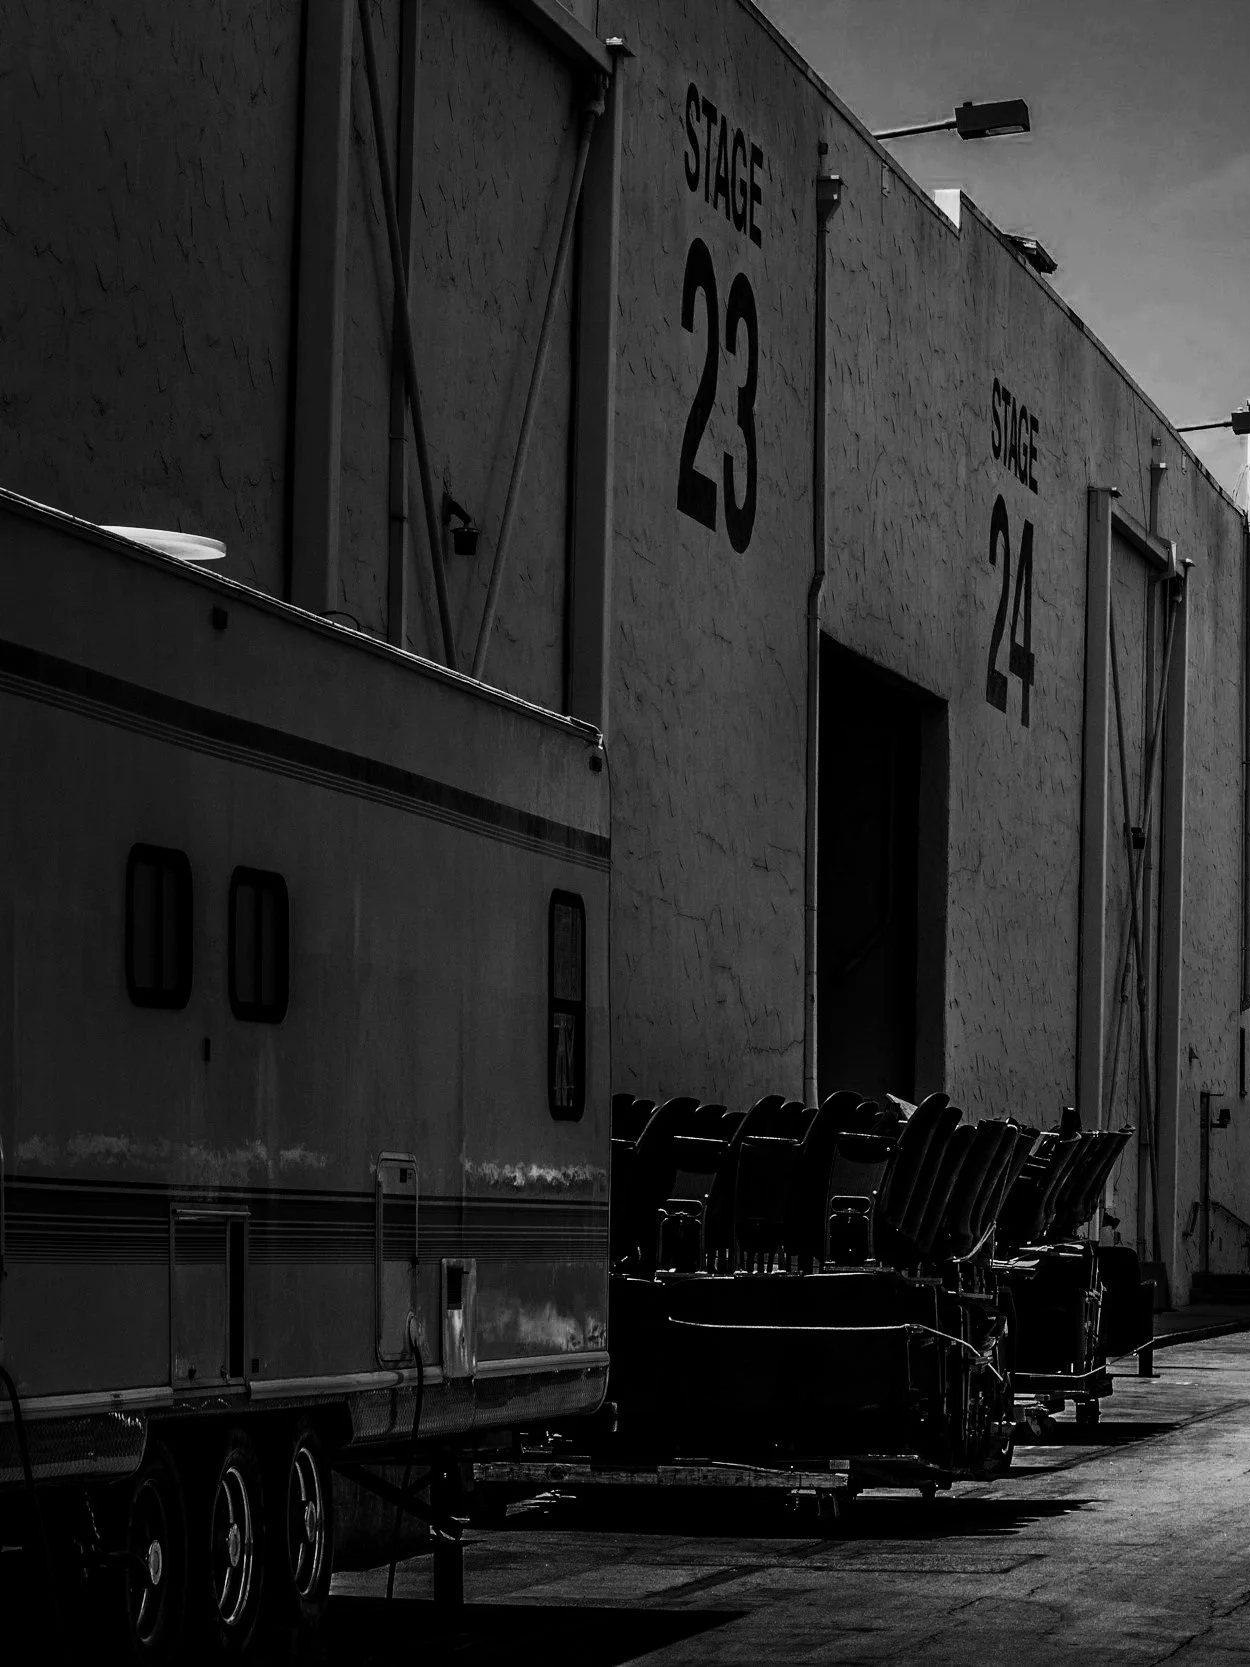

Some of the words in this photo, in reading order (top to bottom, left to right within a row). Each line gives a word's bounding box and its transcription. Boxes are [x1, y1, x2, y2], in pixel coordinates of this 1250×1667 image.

[684, 82, 764, 249] STAGE
[677, 238, 759, 554] 23
[992, 377, 1039, 495] STAGE
[986, 493, 1035, 728] 24
